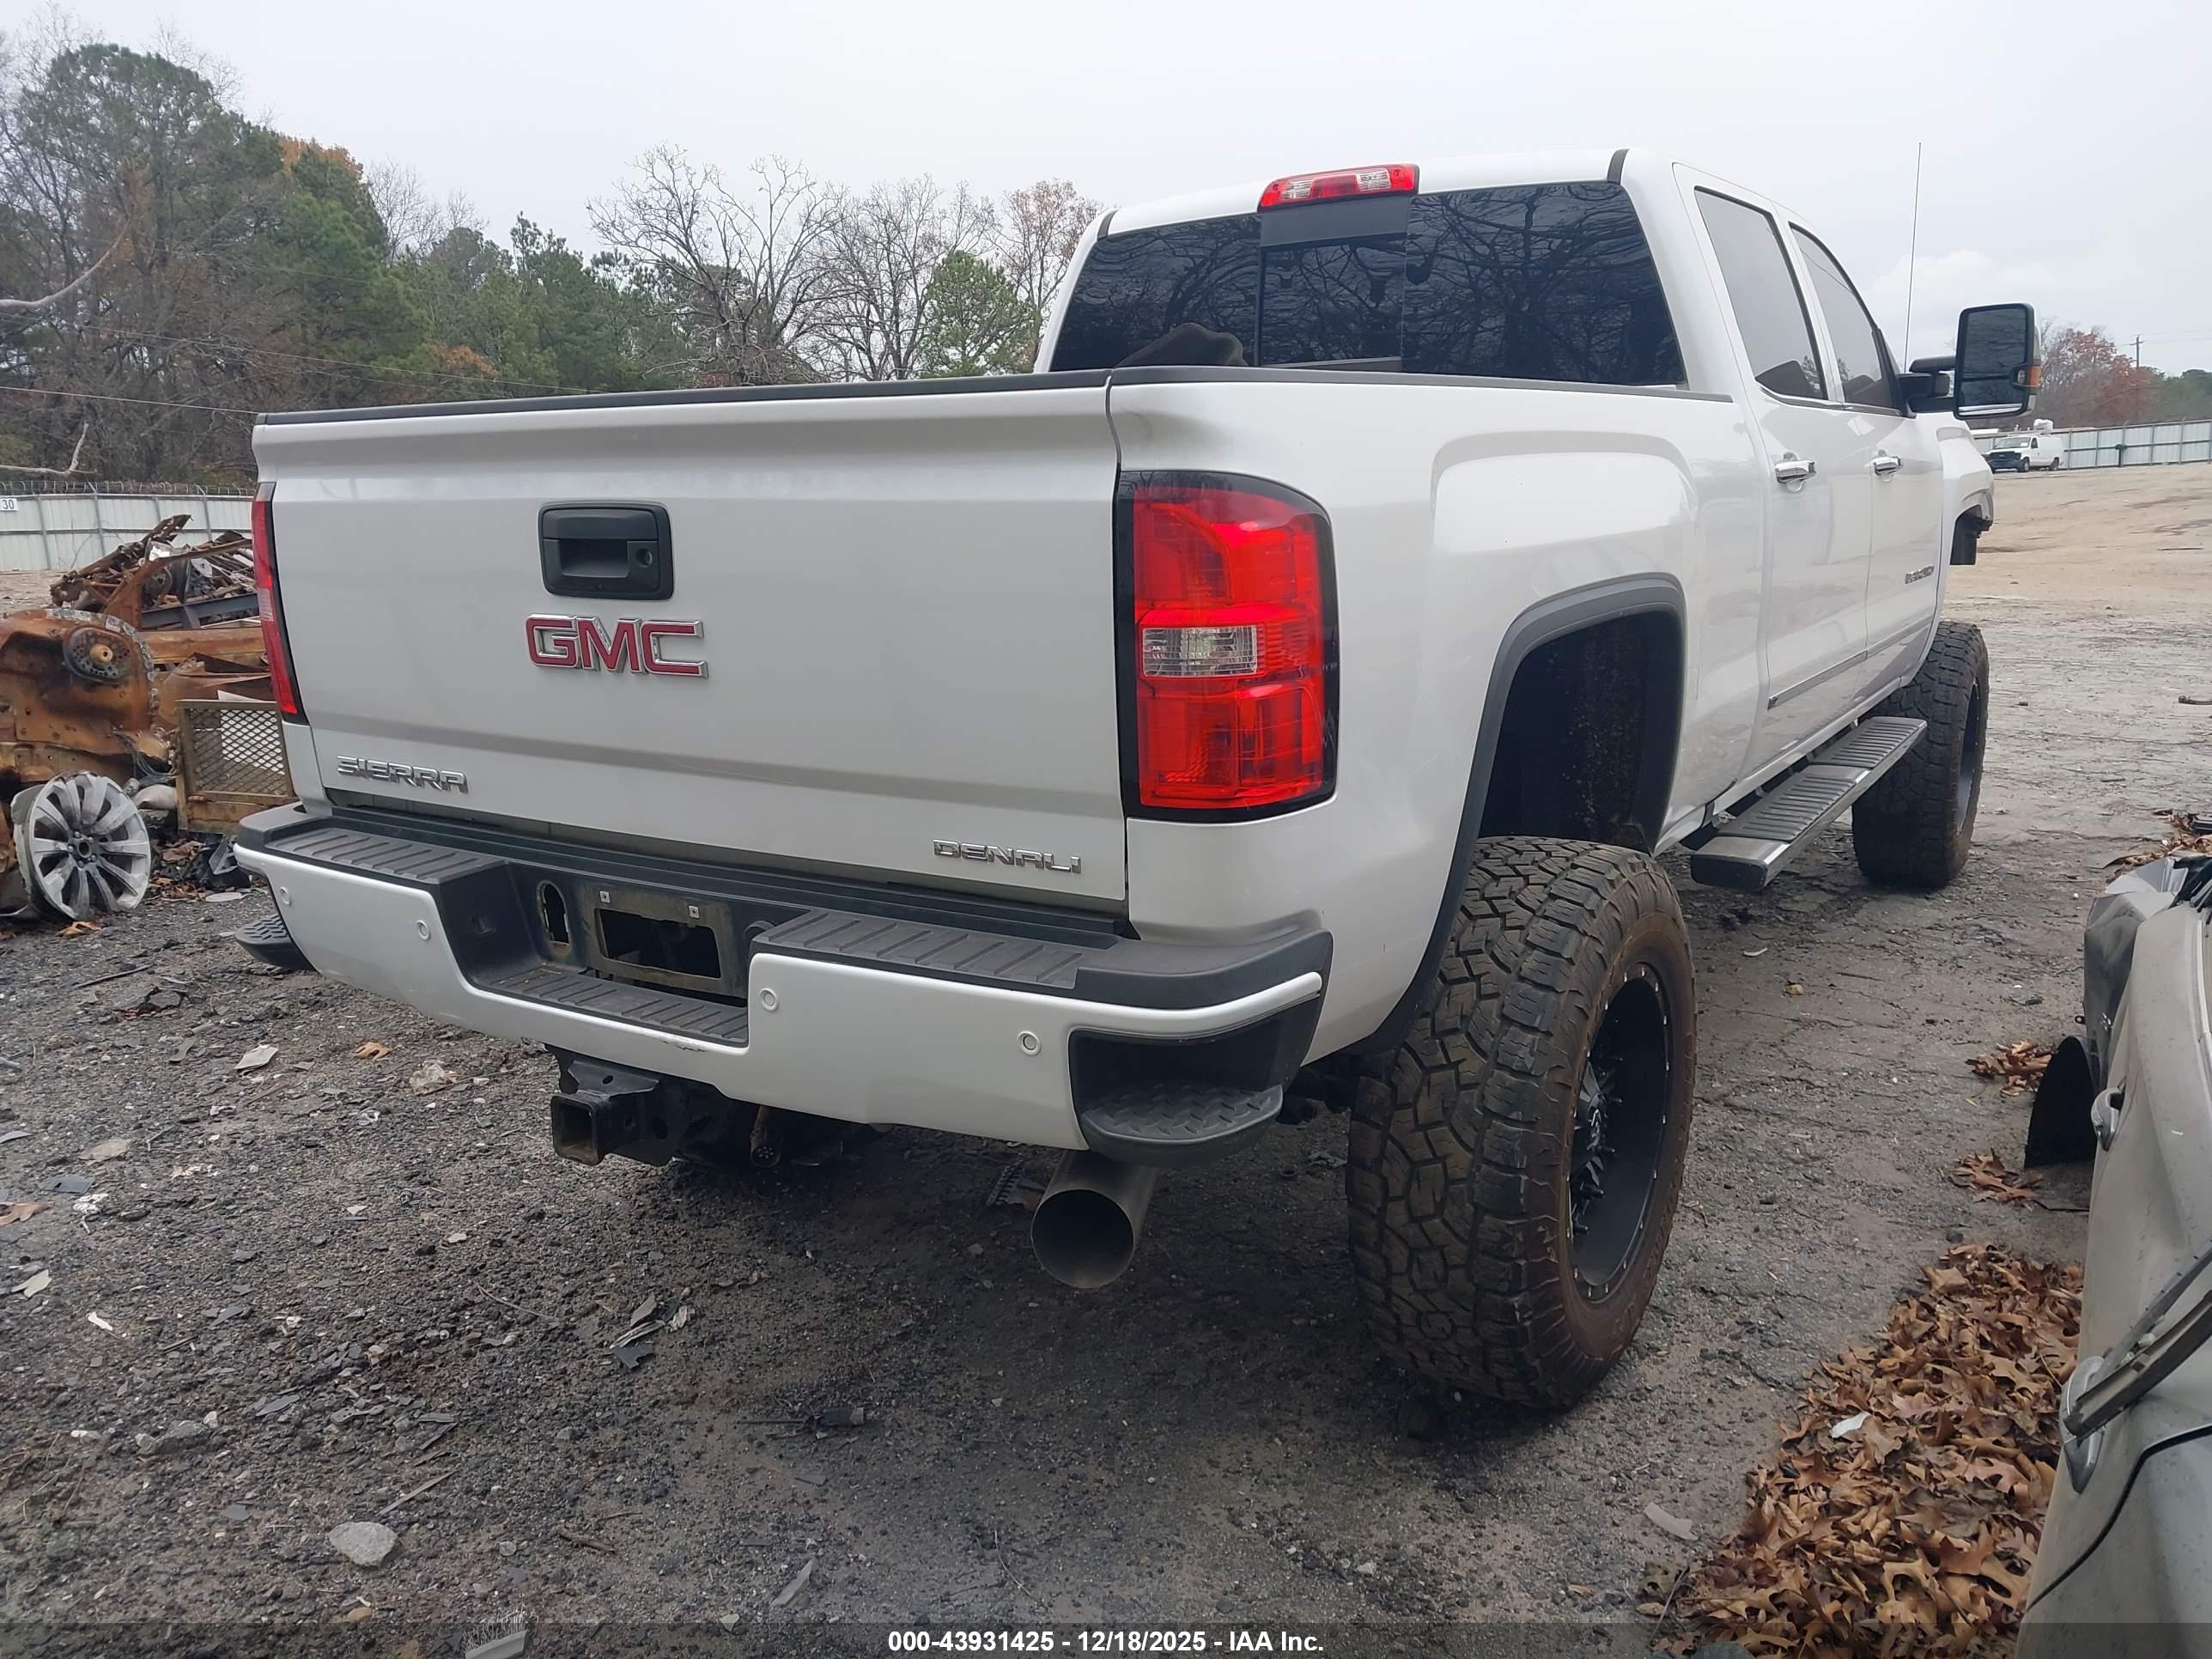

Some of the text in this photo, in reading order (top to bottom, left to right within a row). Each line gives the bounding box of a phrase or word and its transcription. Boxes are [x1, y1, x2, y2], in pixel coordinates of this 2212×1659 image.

[2, 499, 15, 510] 30
[526, 613, 708, 678] GMC
[336, 756, 468, 794] SIERRA
[933, 839, 1081, 873] DENALI
